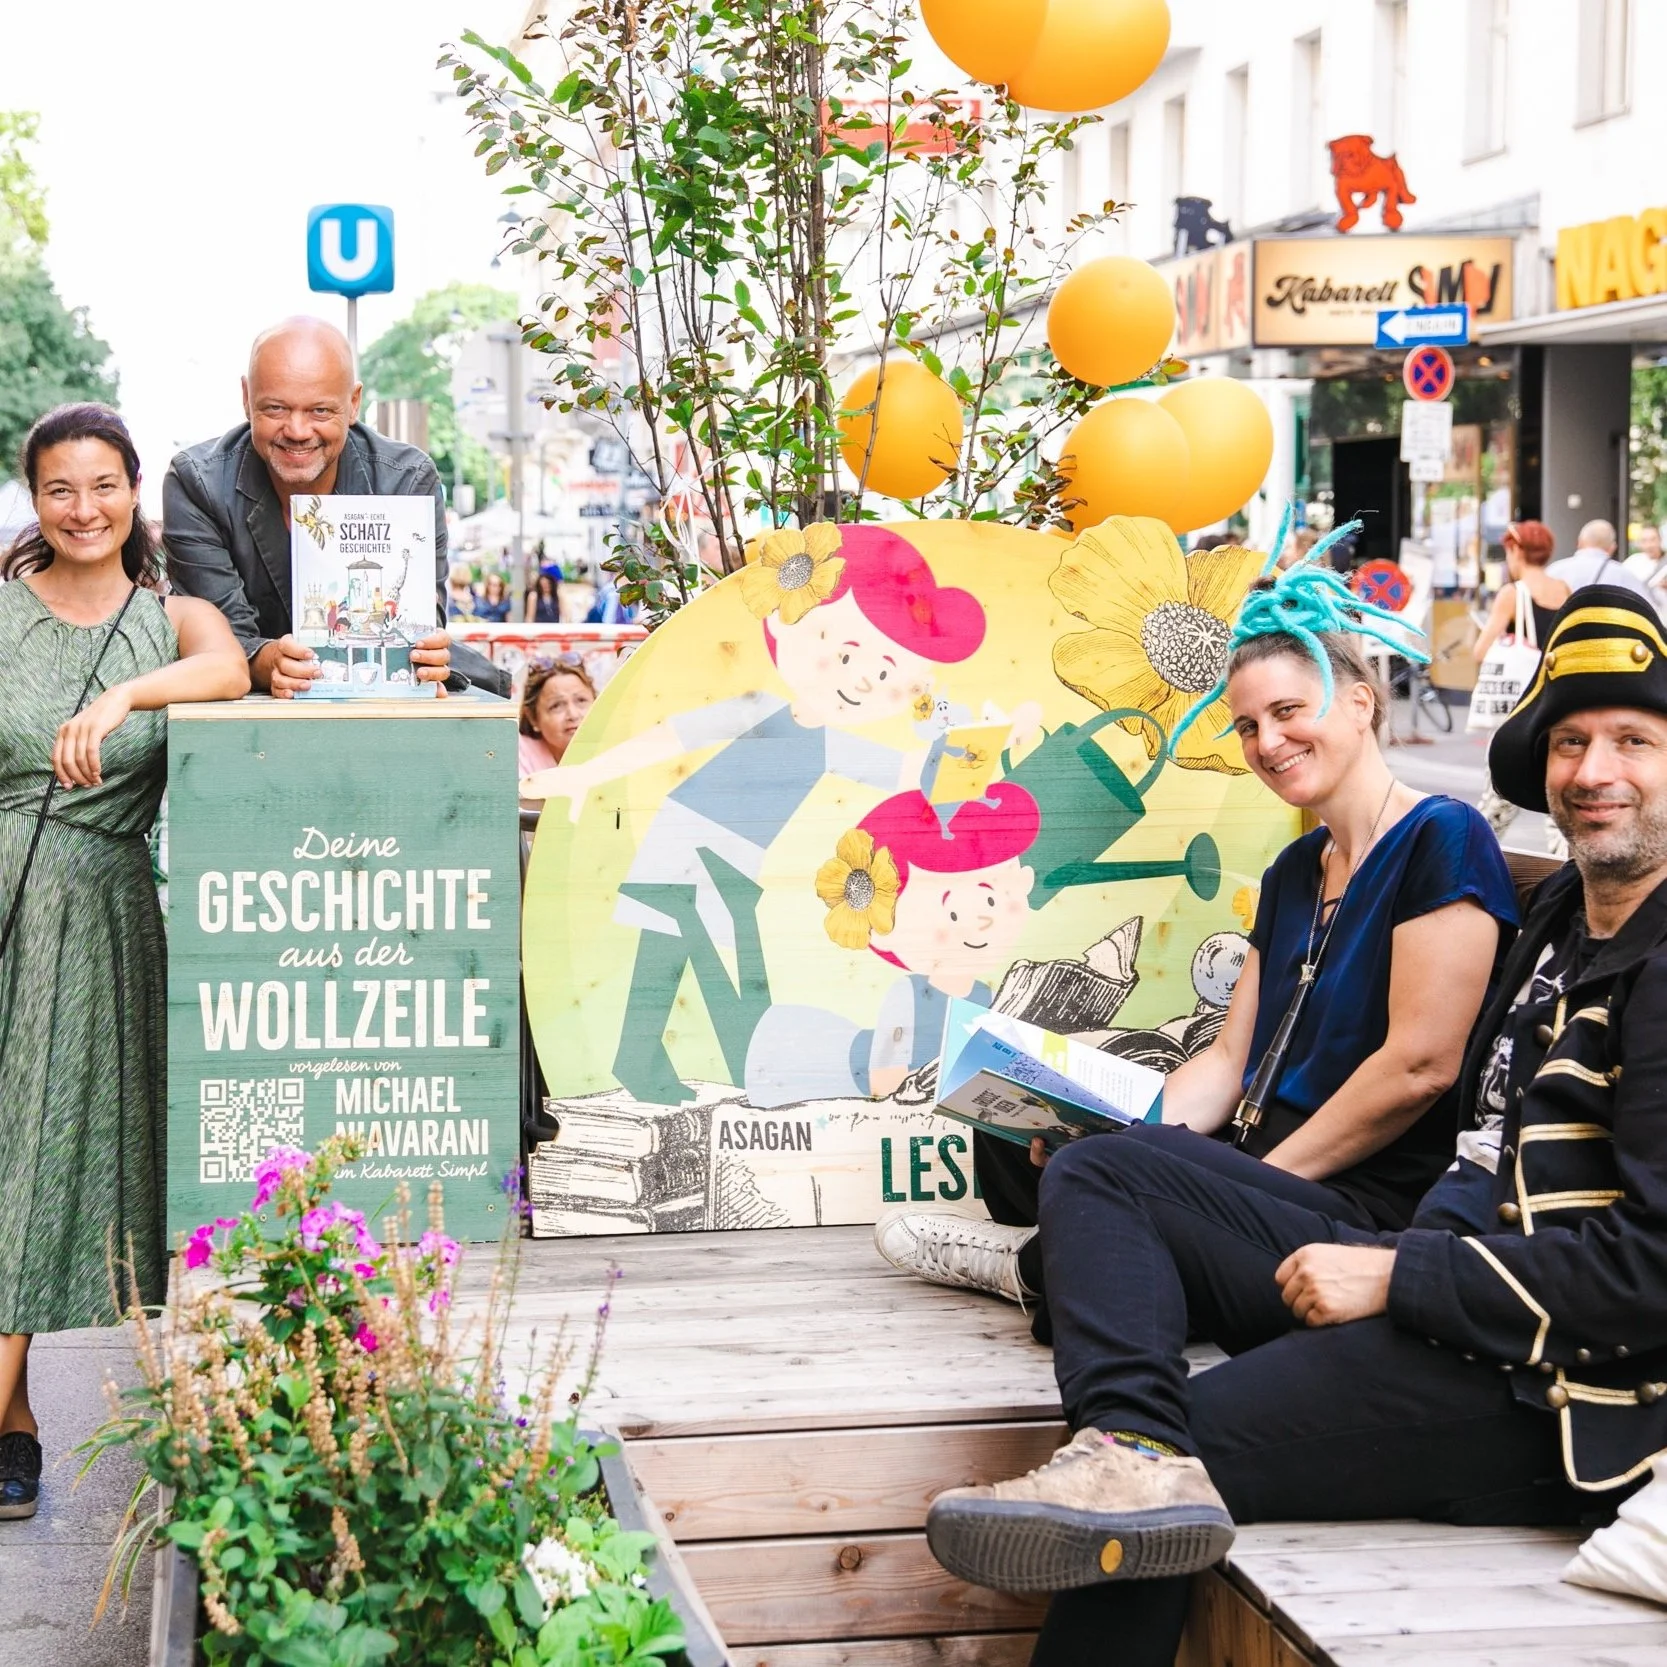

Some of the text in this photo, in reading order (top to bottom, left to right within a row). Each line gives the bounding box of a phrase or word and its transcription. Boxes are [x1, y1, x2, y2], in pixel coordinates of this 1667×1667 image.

[320, 219, 378, 281] U
[340, 522, 391, 541] SCHATZ
[340, 543, 391, 553] GESCHICHTEN
[293, 826, 399, 860] Deine
[198, 869, 491, 933] GESCHICHTE
[278, 936, 414, 968] aus der
[198, 978, 490, 1051] WOLLZEILE
[289, 1057, 402, 1080] vorgelesen von
[335, 1076, 461, 1115] MICHAEL
[719, 1120, 812, 1151] ASAGAN
[360, 1162, 433, 1179] Kabarett
[438, 1160, 488, 1181] Simpl
[881, 1134, 984, 1203] LES
